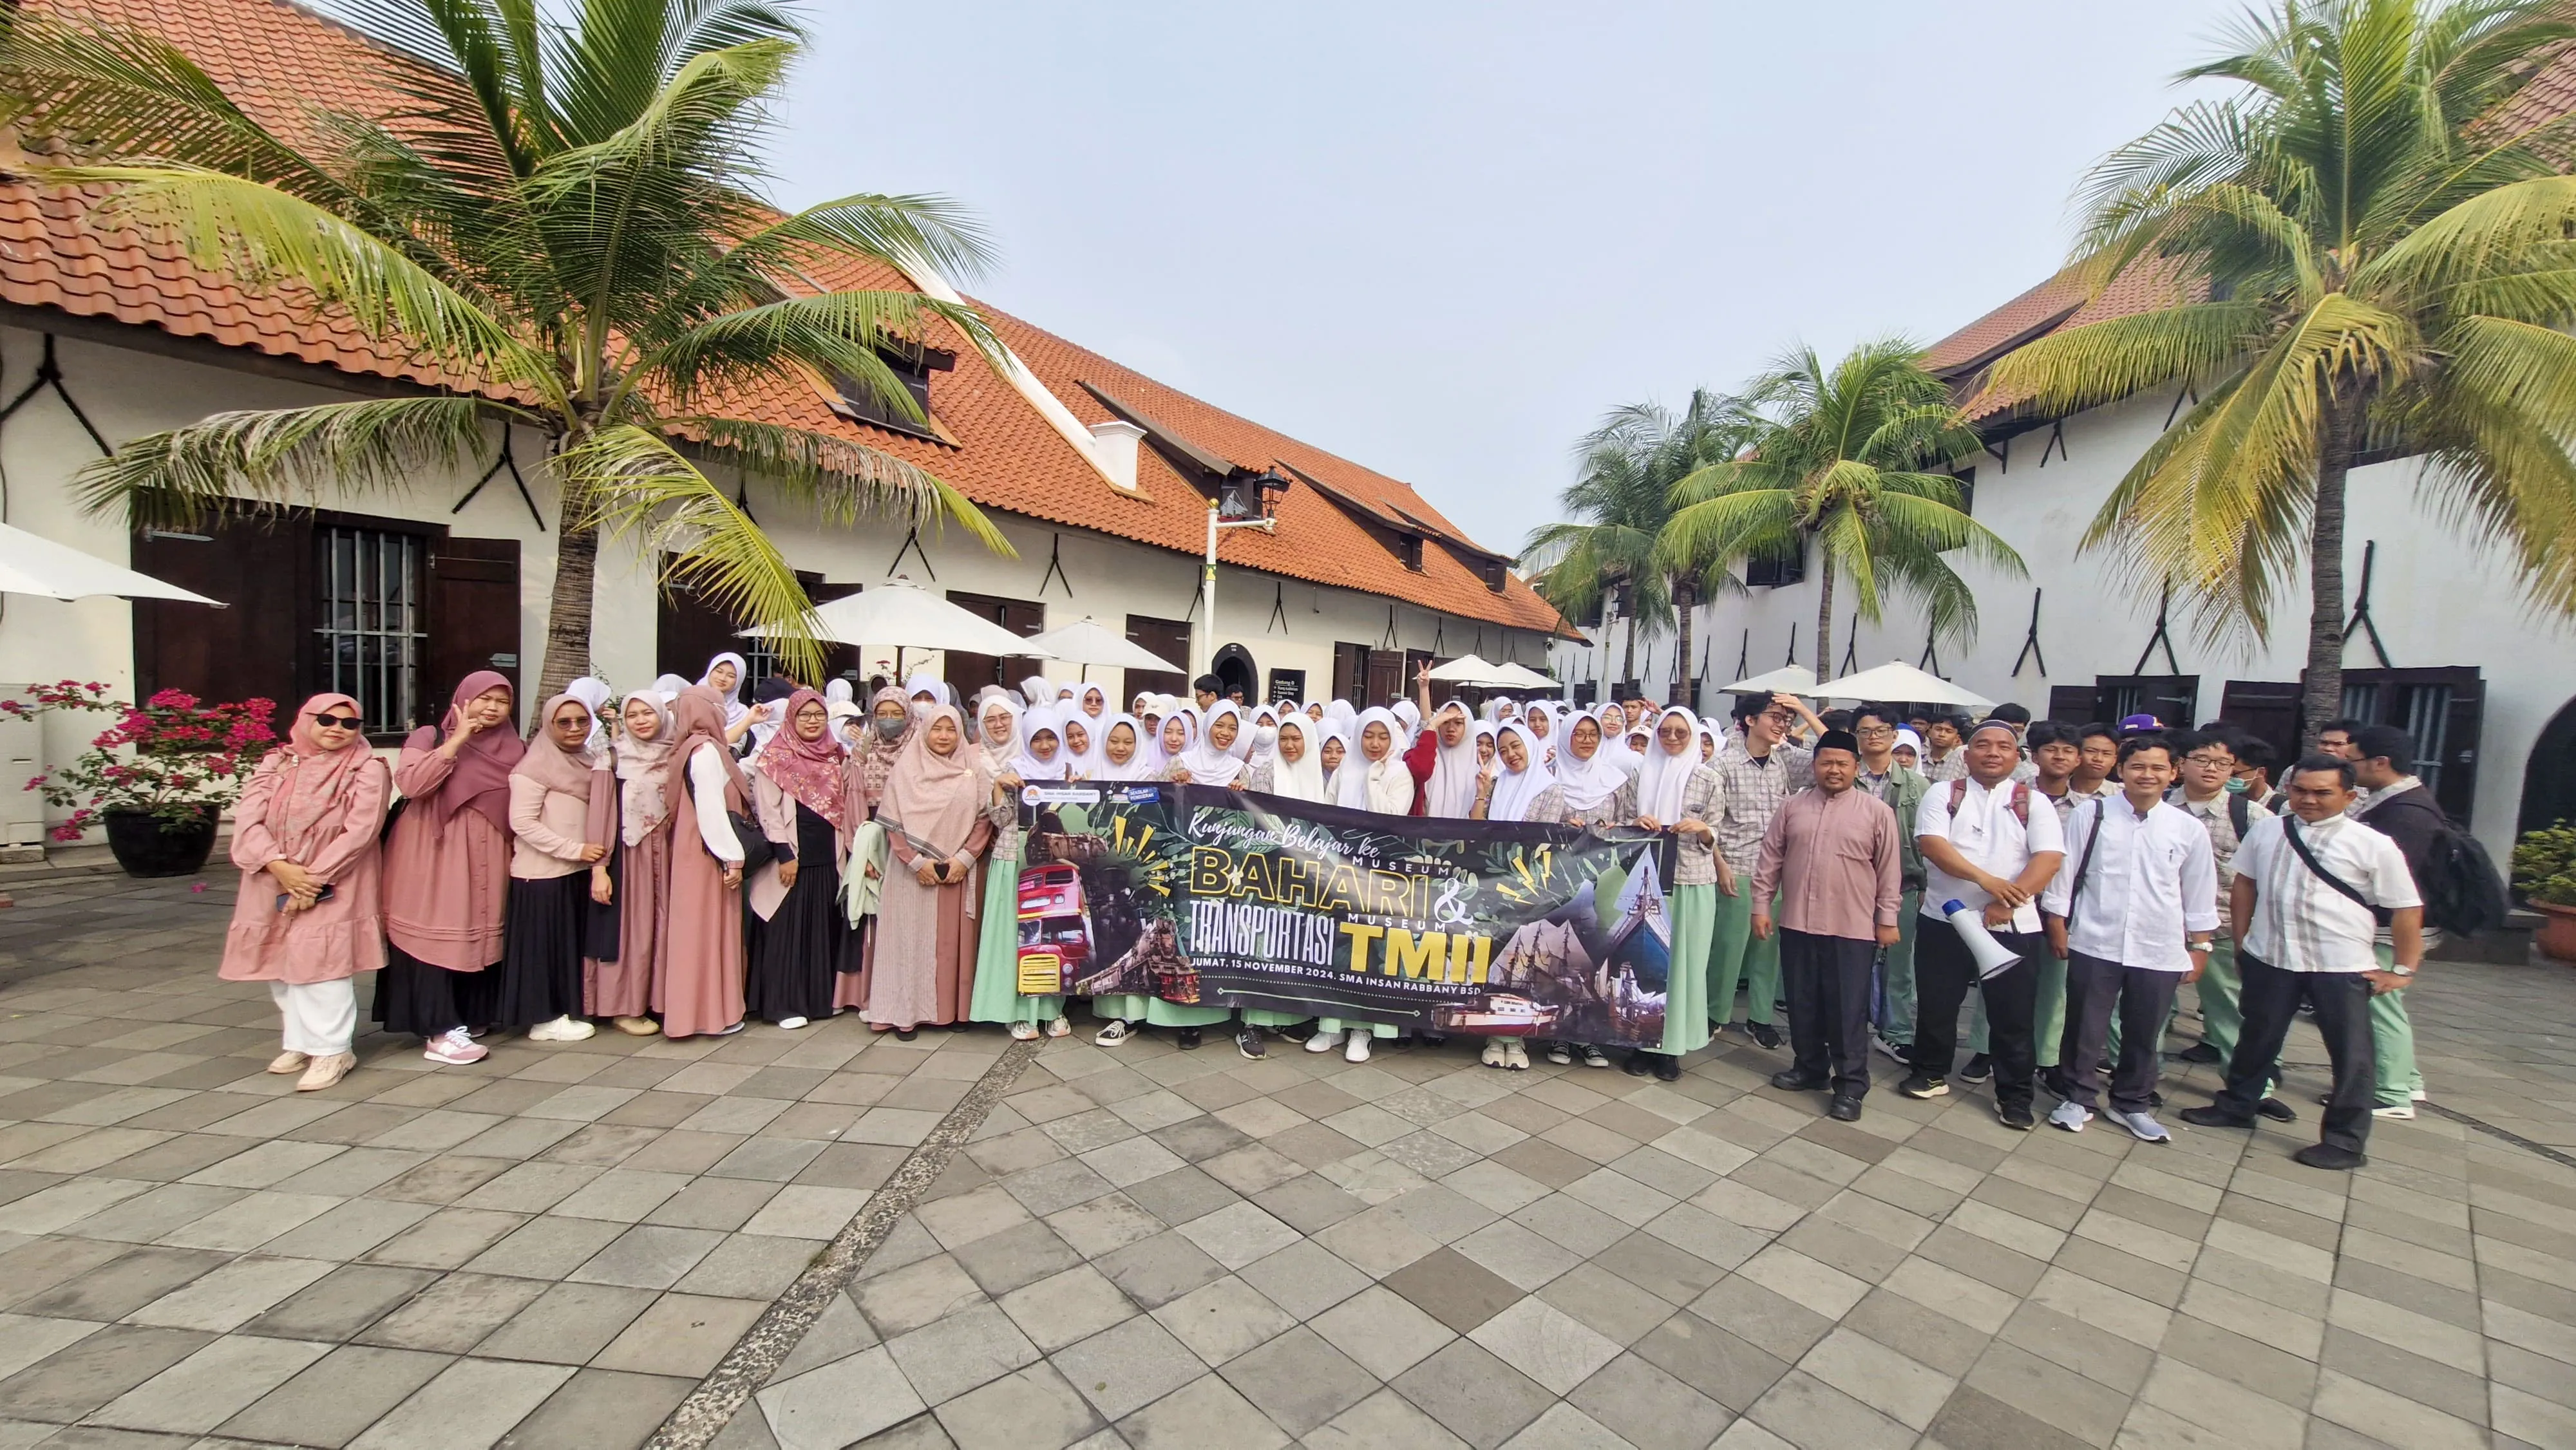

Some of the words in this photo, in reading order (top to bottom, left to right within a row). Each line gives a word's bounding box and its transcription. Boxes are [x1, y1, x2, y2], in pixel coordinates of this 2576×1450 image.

[1188, 812, 1278, 849] Kunjungan
[1281, 824, 1354, 860] Belajar
[1358, 836, 1380, 858] ke
[1189, 845, 1429, 919] BAHARI
[1434, 878, 1474, 925] &
[1352, 855, 1449, 876] MUSEUM
[1189, 899, 1335, 966] TRANSPORTASI
[1339, 921, 1492, 984] TMII
[1347, 912, 1446, 933] MUSEUM
[1190, 957, 1229, 968] JUMAT,
[1231, 959, 1242, 968] 15
[1244, 961, 1303, 975] NOVEMBER
[1305, 967, 1337, 980] 2024.
[1339, 973, 1363, 984] SMA
[1366, 977, 1401, 989] INSAN
[1403, 981, 1458, 995] RABBANY
[1460, 986, 1481, 995] BSD
